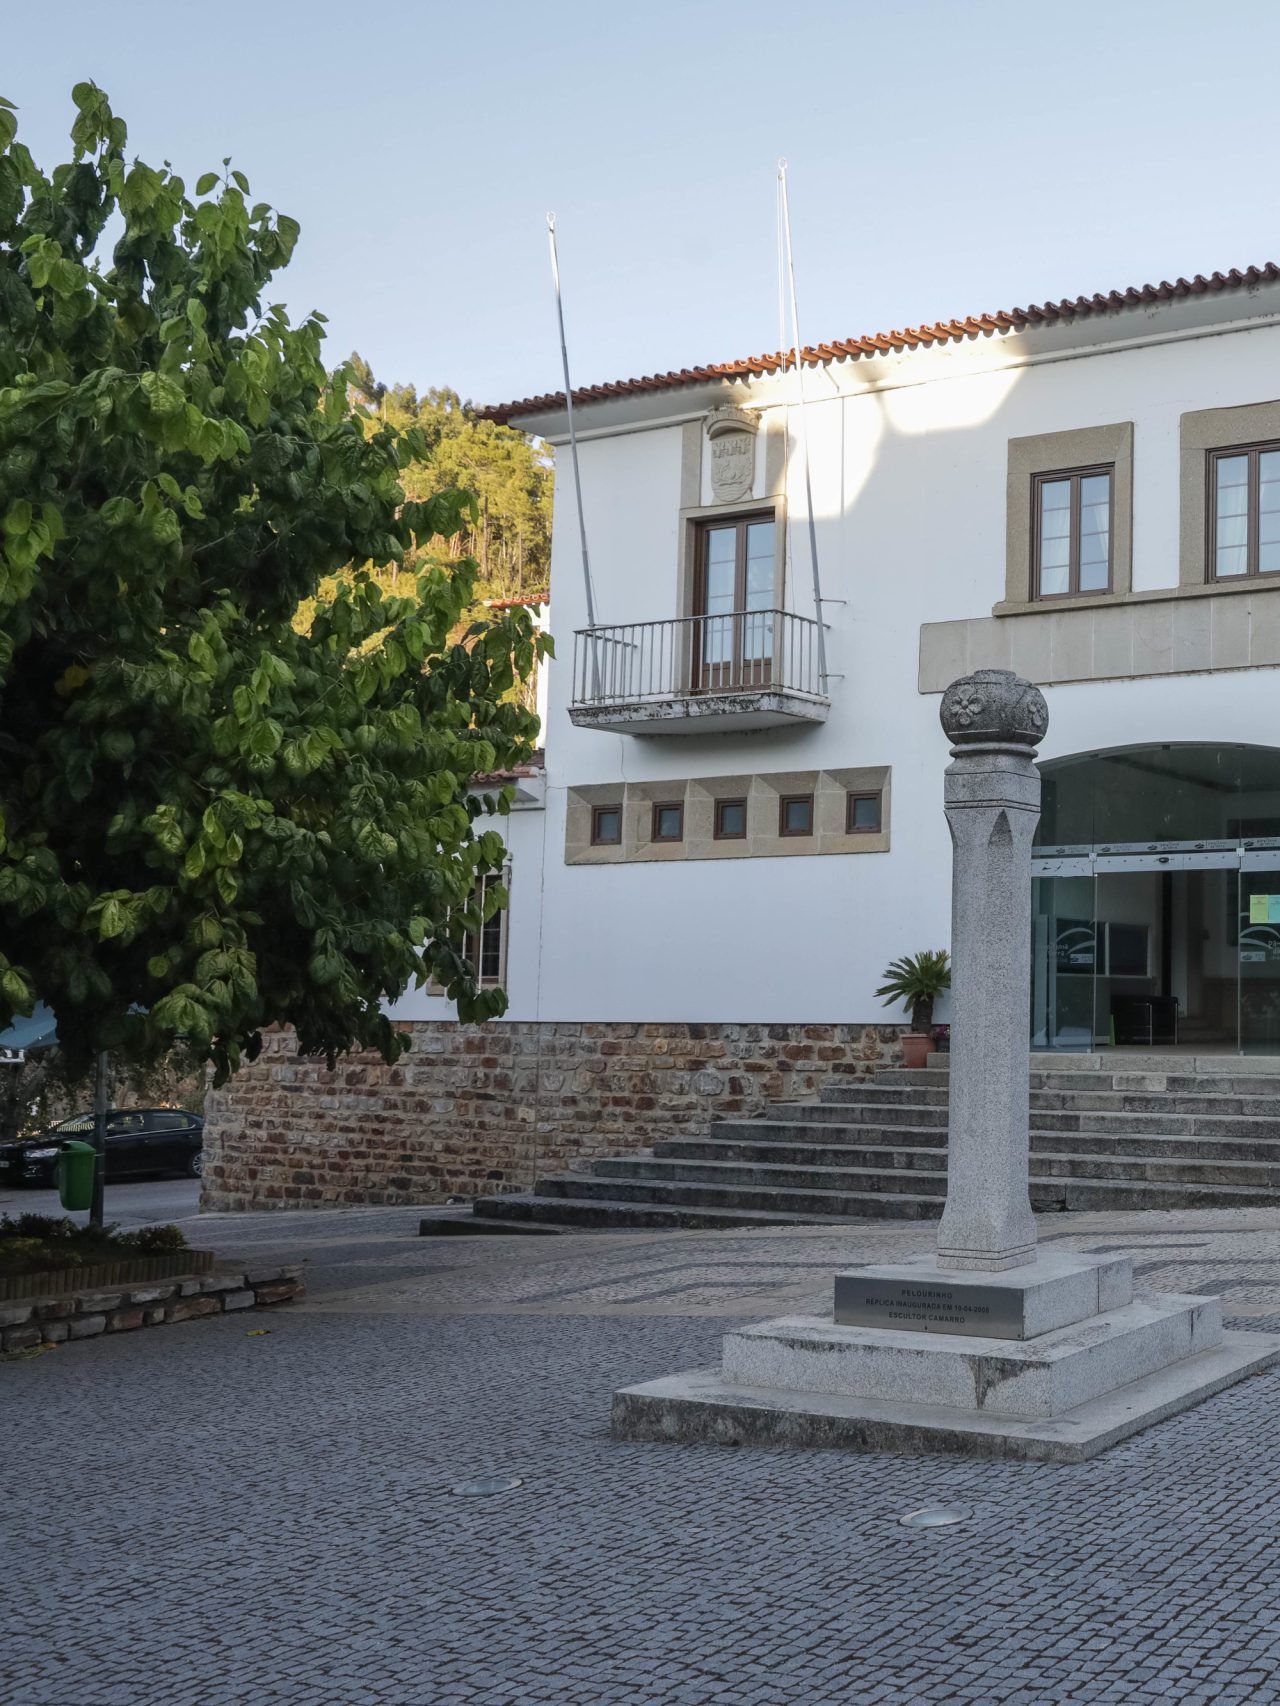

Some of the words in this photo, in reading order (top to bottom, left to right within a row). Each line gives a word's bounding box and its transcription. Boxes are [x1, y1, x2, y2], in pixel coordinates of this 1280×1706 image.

[901, 1289, 953, 1299] PELOURINHO
[896, 1300, 941, 1310] INAUGURADA
[942, 1303, 953, 1311] EM
[888, 1311, 927, 1321] ESCULTOR
